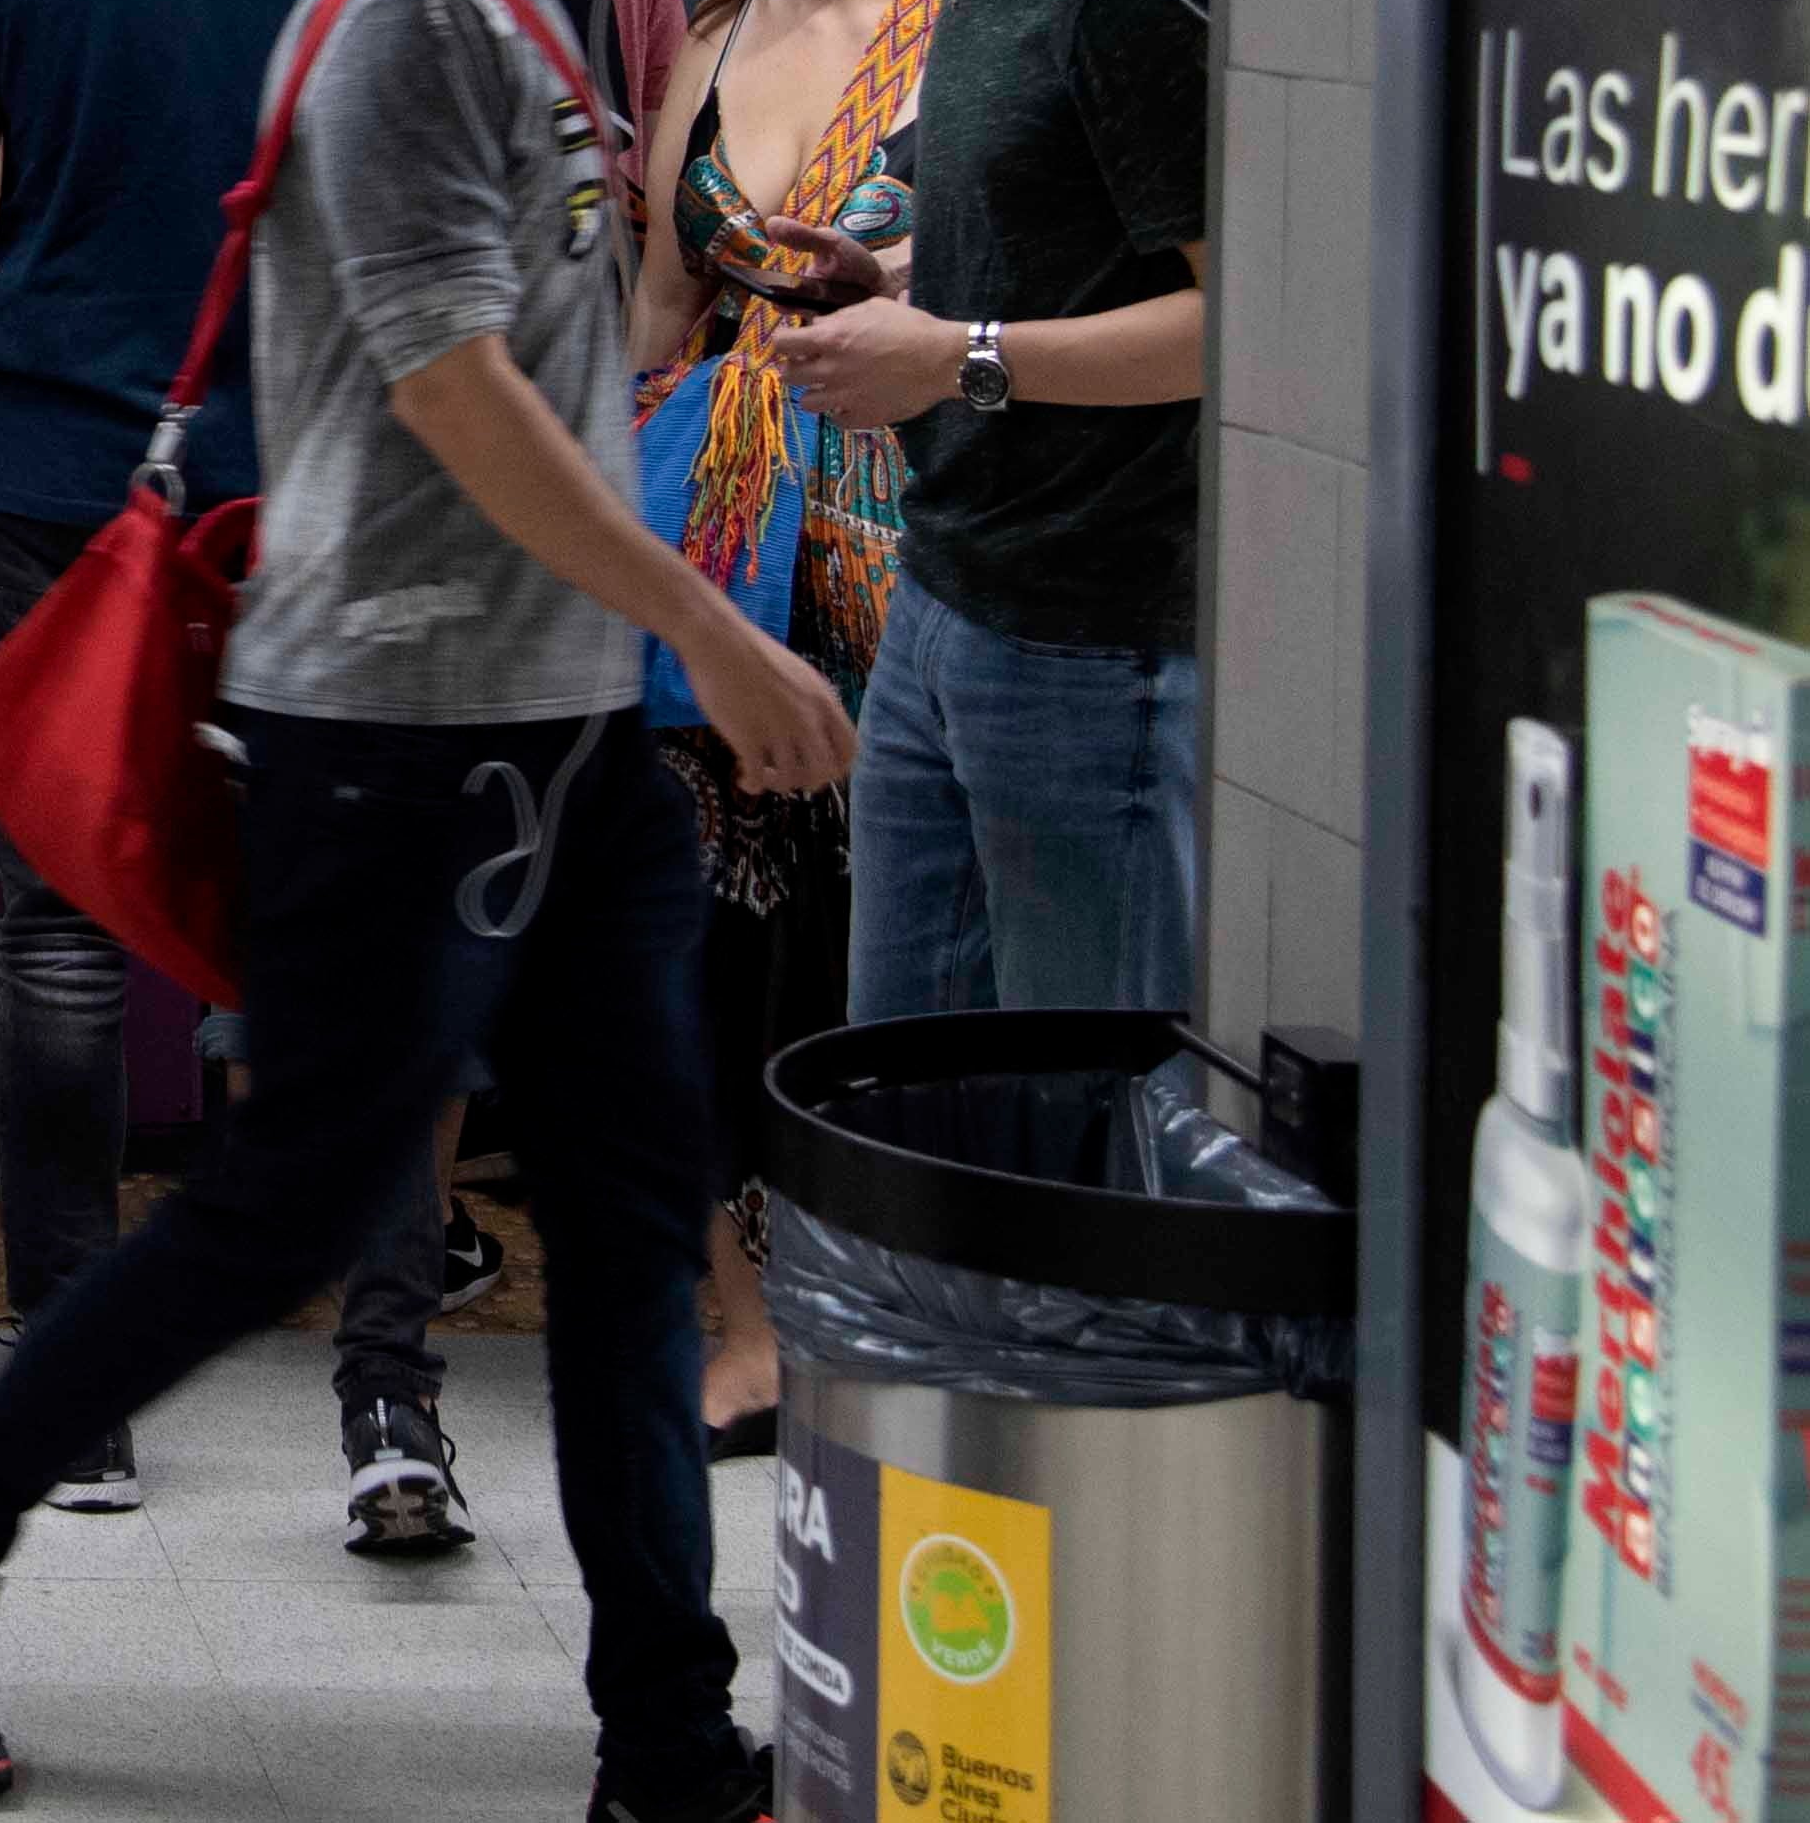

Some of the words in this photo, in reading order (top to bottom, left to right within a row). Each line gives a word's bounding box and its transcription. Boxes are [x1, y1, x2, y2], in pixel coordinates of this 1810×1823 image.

[1501, 28, 1633, 193] Las
[1651, 32, 1810, 215] her
[1496, 244, 1585, 400] ya
[1602, 263, 1717, 404] no
[940, 1743, 1036, 1792] Buenos
[940, 1774, 1002, 1810] Aires
